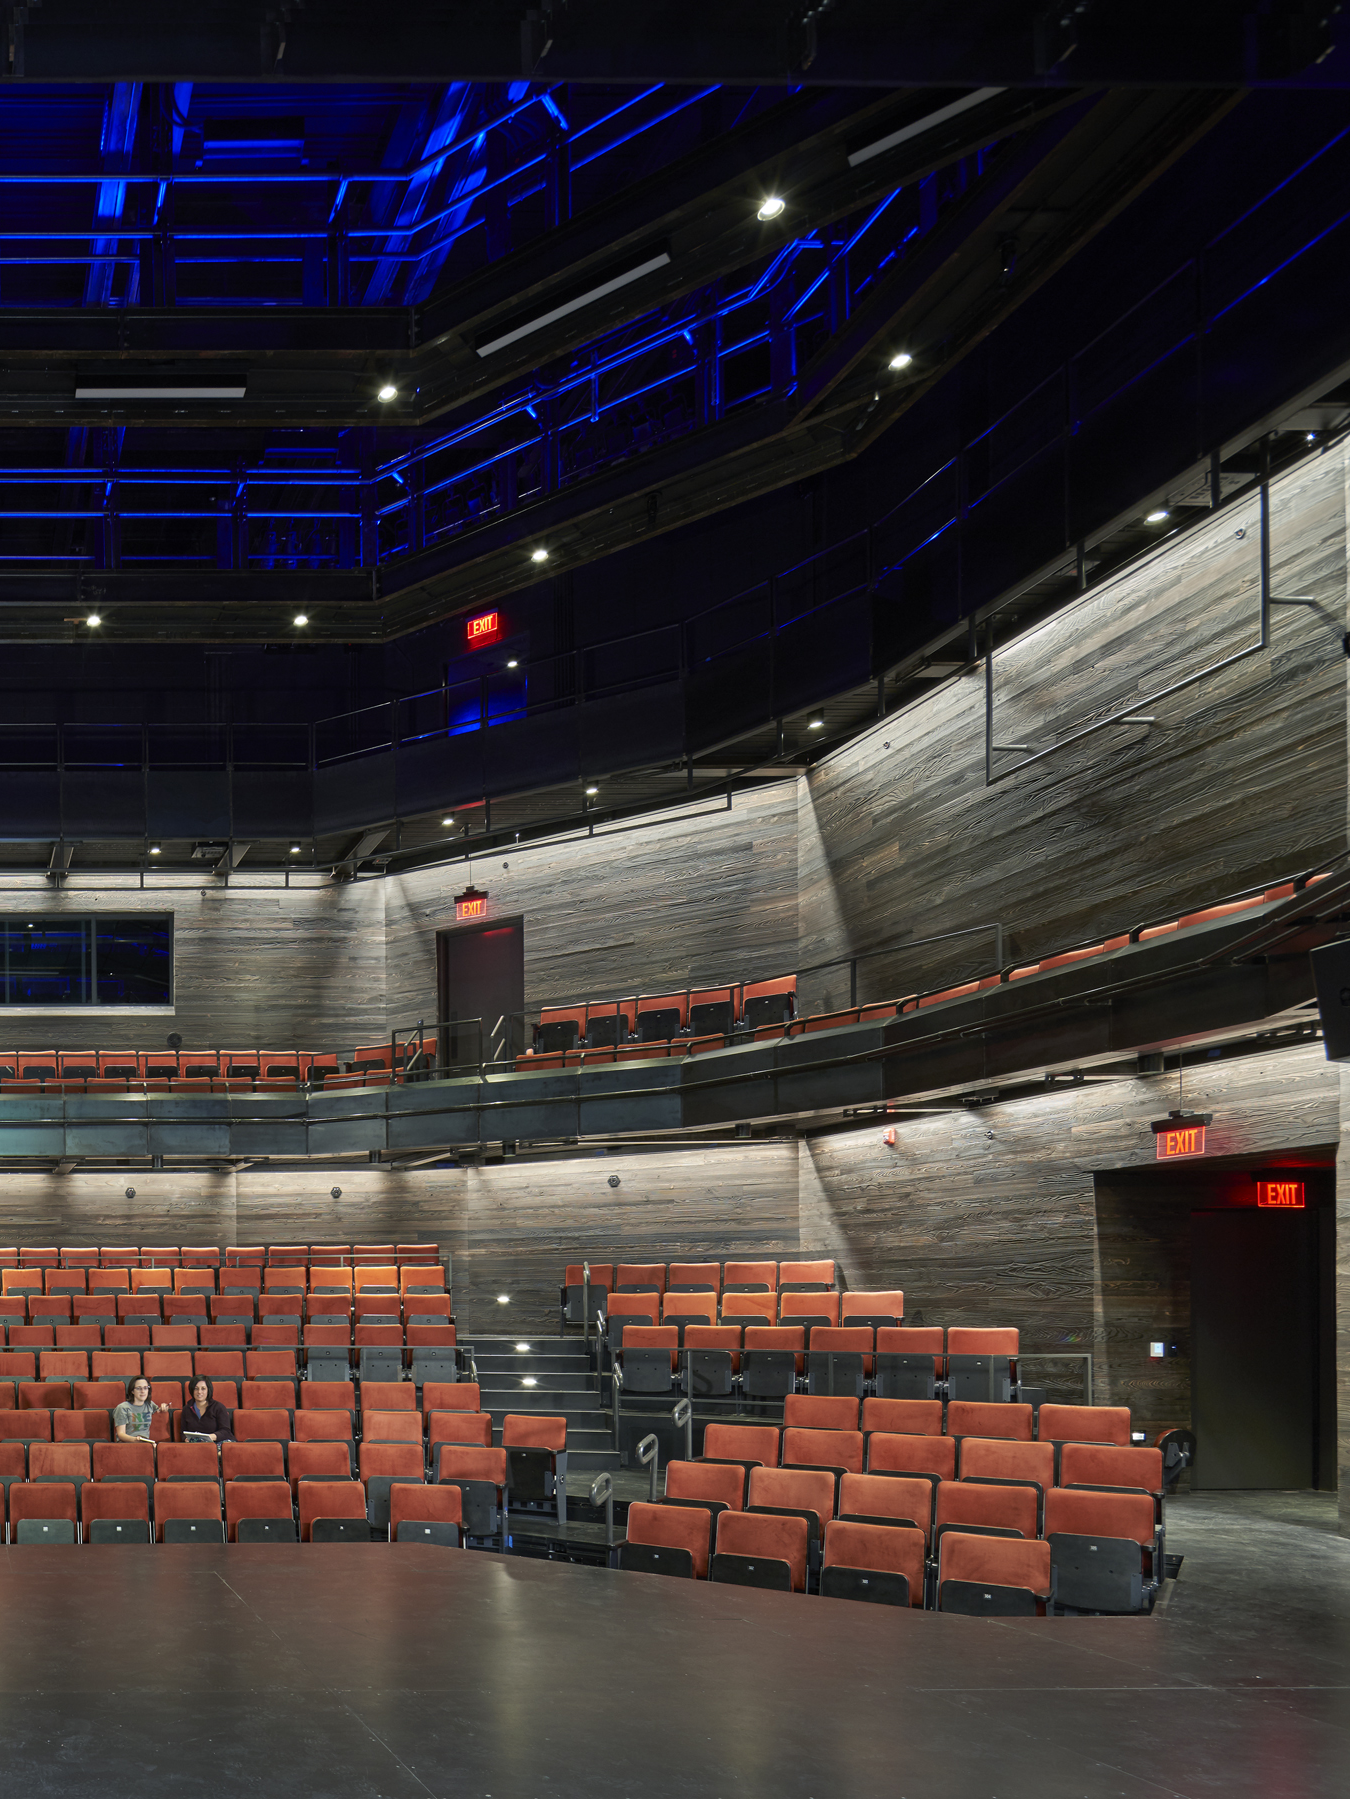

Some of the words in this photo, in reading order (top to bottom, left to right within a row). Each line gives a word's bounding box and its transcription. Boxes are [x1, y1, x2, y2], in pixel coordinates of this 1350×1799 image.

[474, 615, 493, 634] EXIT
[462, 900, 482, 917] EXIT
[1167, 1129, 1198, 1155] EXIT
[1268, 1184, 1298, 1204] EXIT
